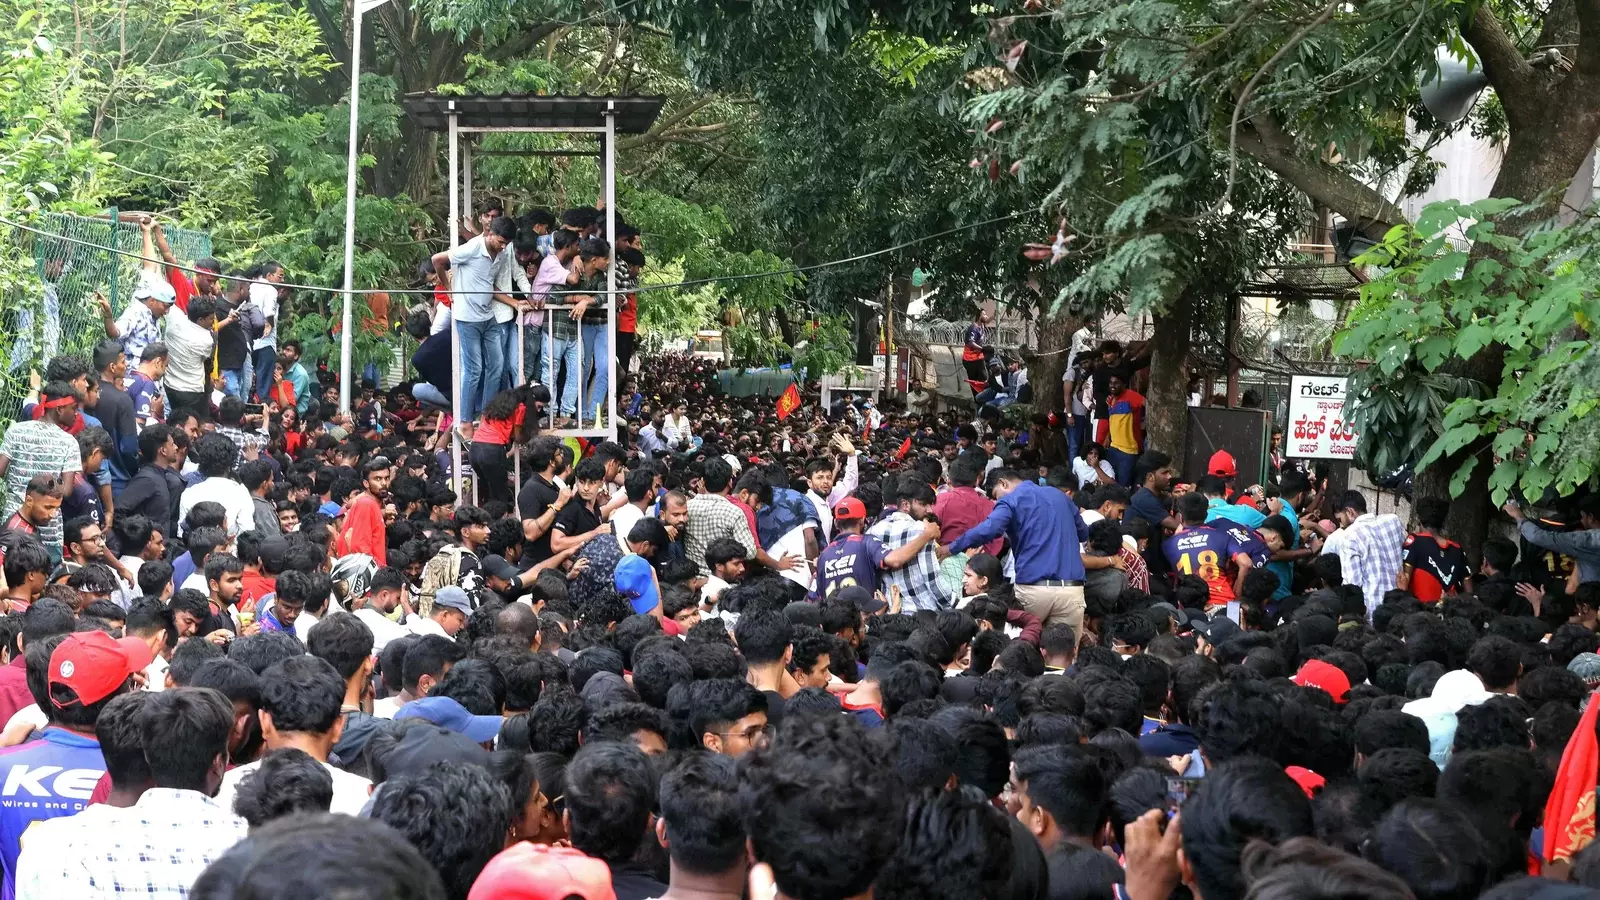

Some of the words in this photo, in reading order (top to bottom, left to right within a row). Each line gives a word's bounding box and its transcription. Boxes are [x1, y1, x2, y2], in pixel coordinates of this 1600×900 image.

[1294, 413, 1326, 440] ಹೆಚ್
[824, 554, 857, 572] KEI
[1176, 549, 1220, 582] 18
[2, 800, 38, 808] Wires
[45, 802, 68, 810] and
